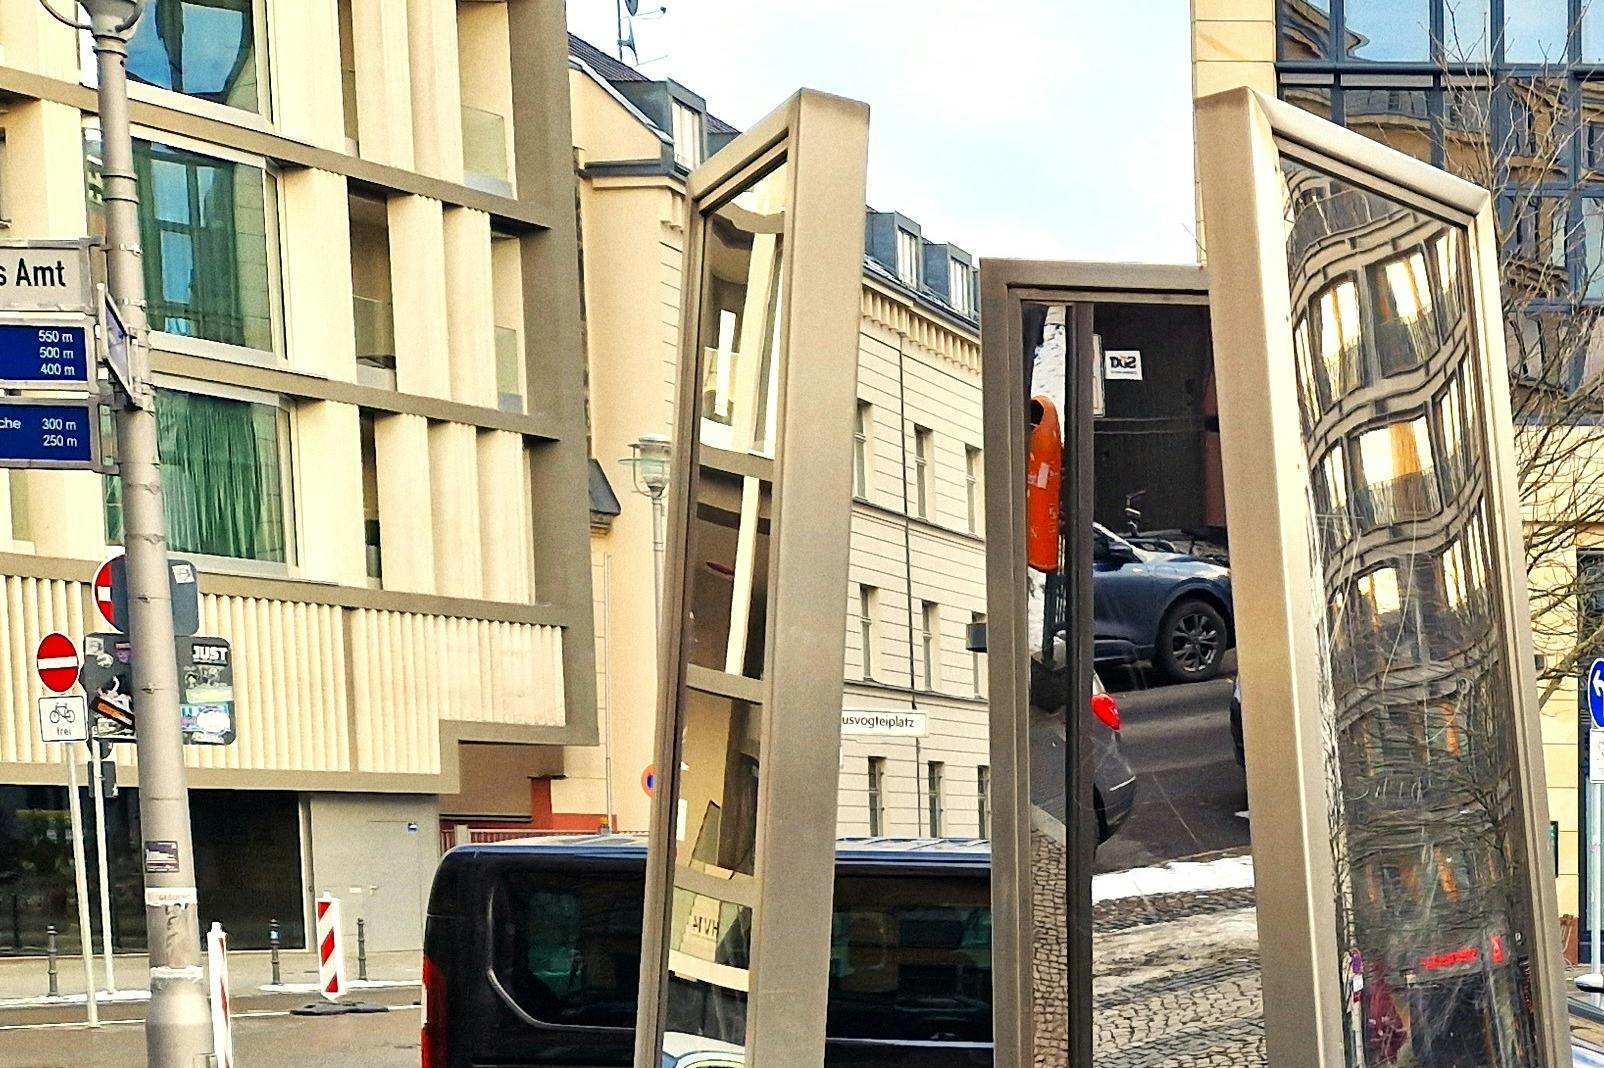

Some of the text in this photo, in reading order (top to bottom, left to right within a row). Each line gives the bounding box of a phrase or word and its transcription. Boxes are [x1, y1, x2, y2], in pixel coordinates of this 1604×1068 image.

[16, 257, 66, 287] Amt
[38, 329, 74, 343] 550 m
[39, 346, 74, 359] 500 m
[40, 363, 75, 376] 400 m
[41, 418, 63, 431] 300
[65, 421, 77, 431] m
[42, 435, 78, 447] 250 m
[193, 645, 228, 662] JUST
[57, 726, 72, 736] frei
